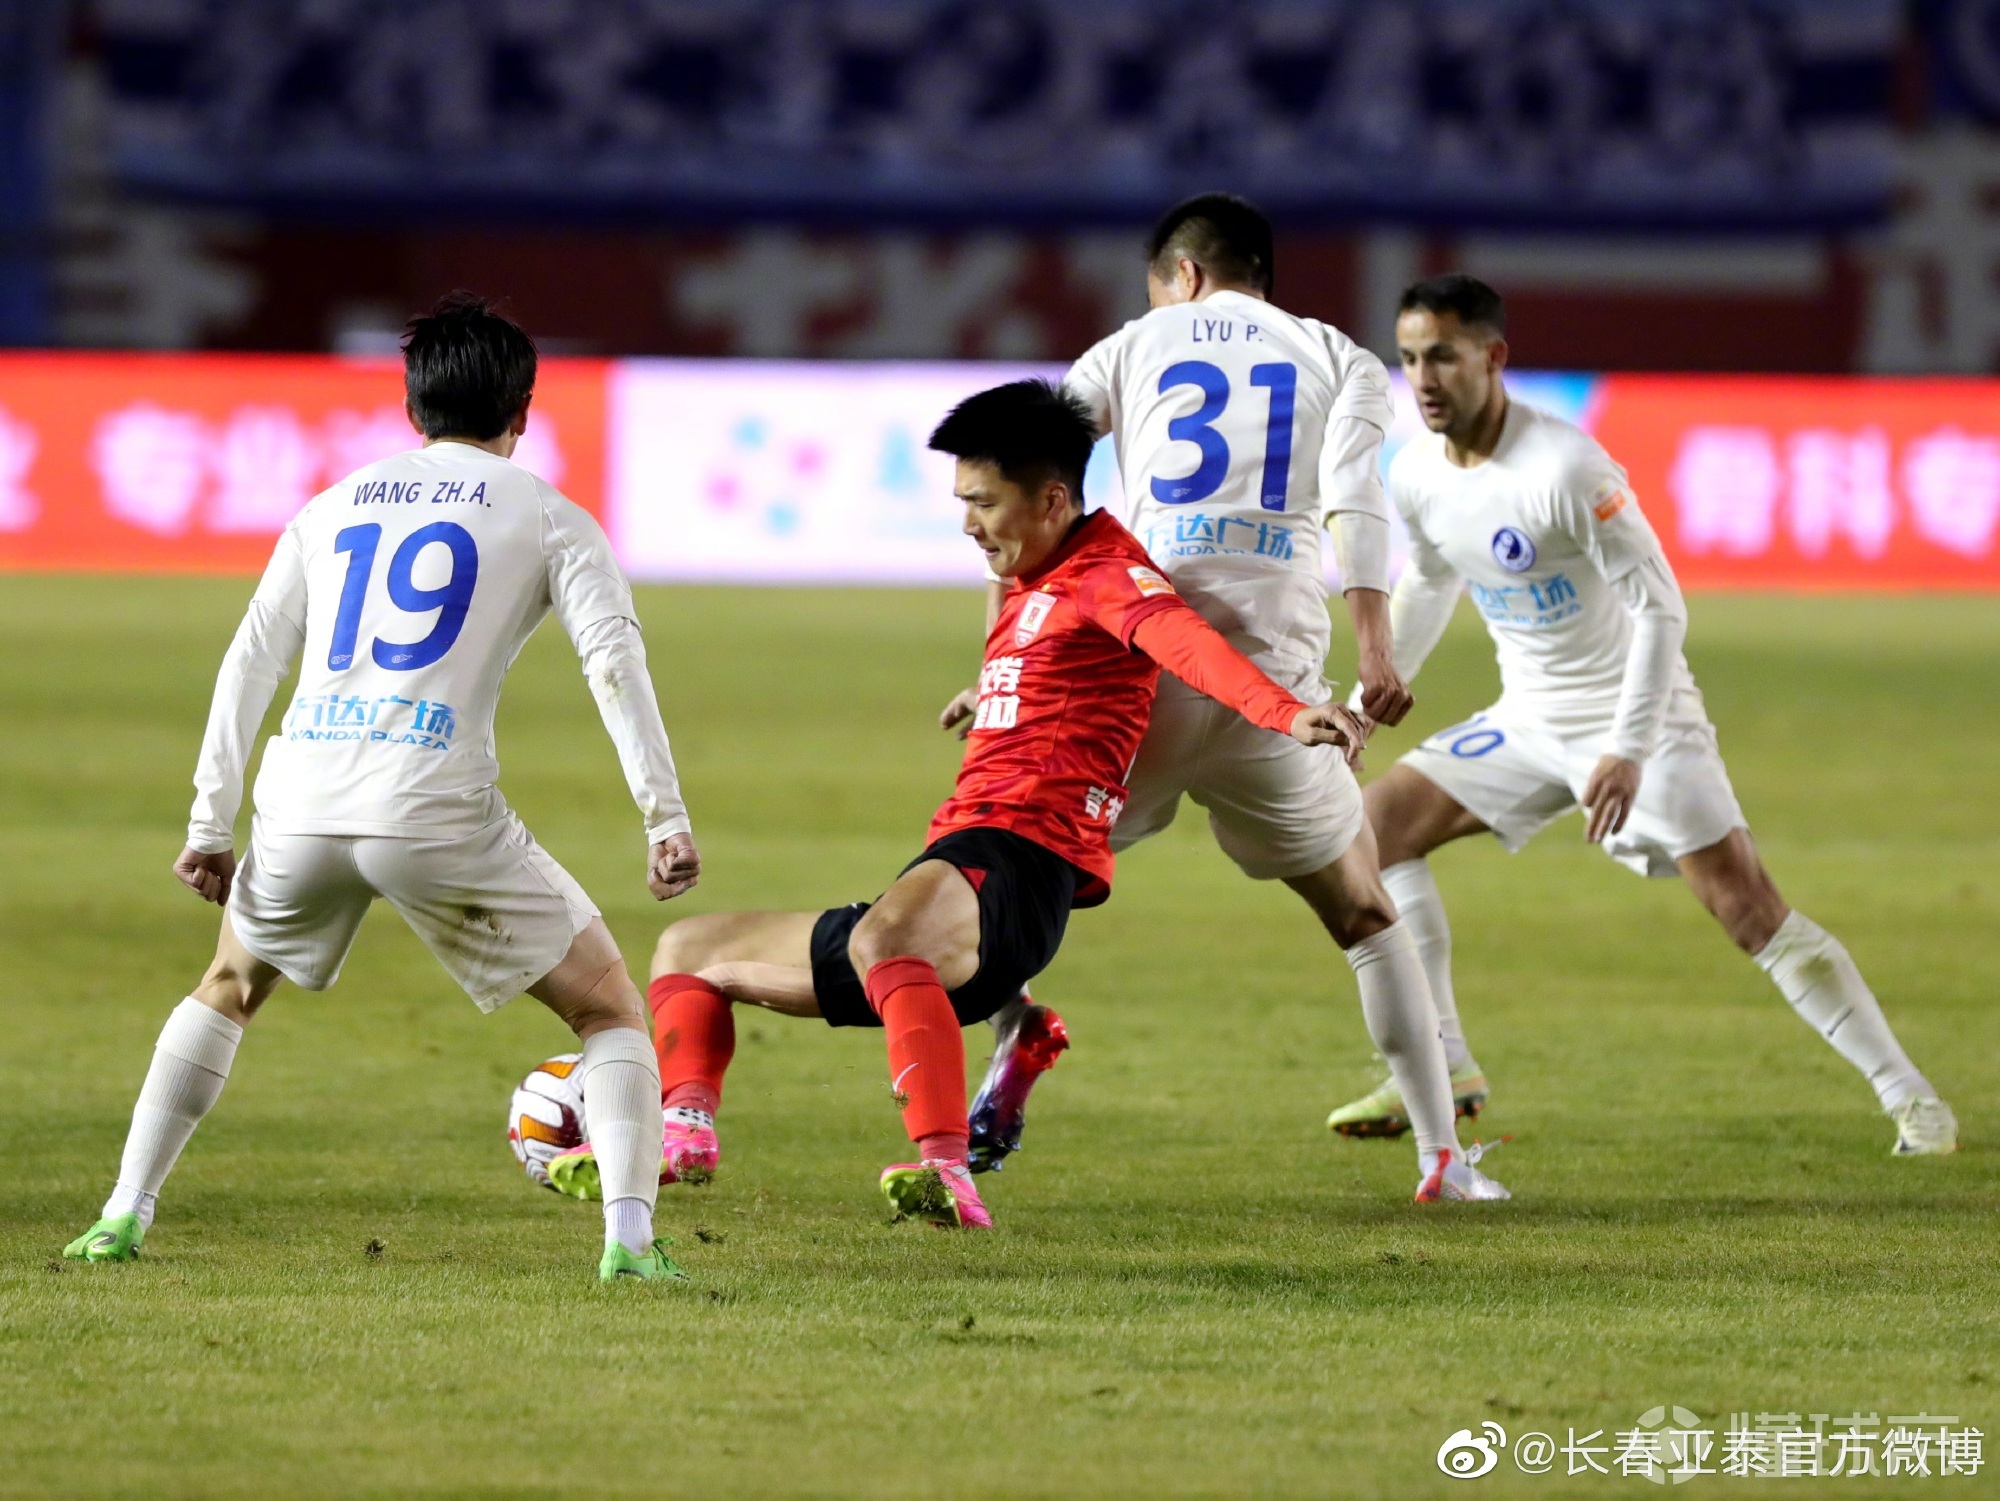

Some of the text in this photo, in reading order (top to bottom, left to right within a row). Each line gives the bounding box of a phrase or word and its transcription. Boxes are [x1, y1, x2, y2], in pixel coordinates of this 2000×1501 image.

[1192, 318, 1263, 342] LYU P.
[1150, 360, 1297, 512] 31
[353, 481, 491, 508] WANG ZH.A.
[327, 521, 479, 671] 19
[290, 729, 450, 750] WANDA PLAZA
